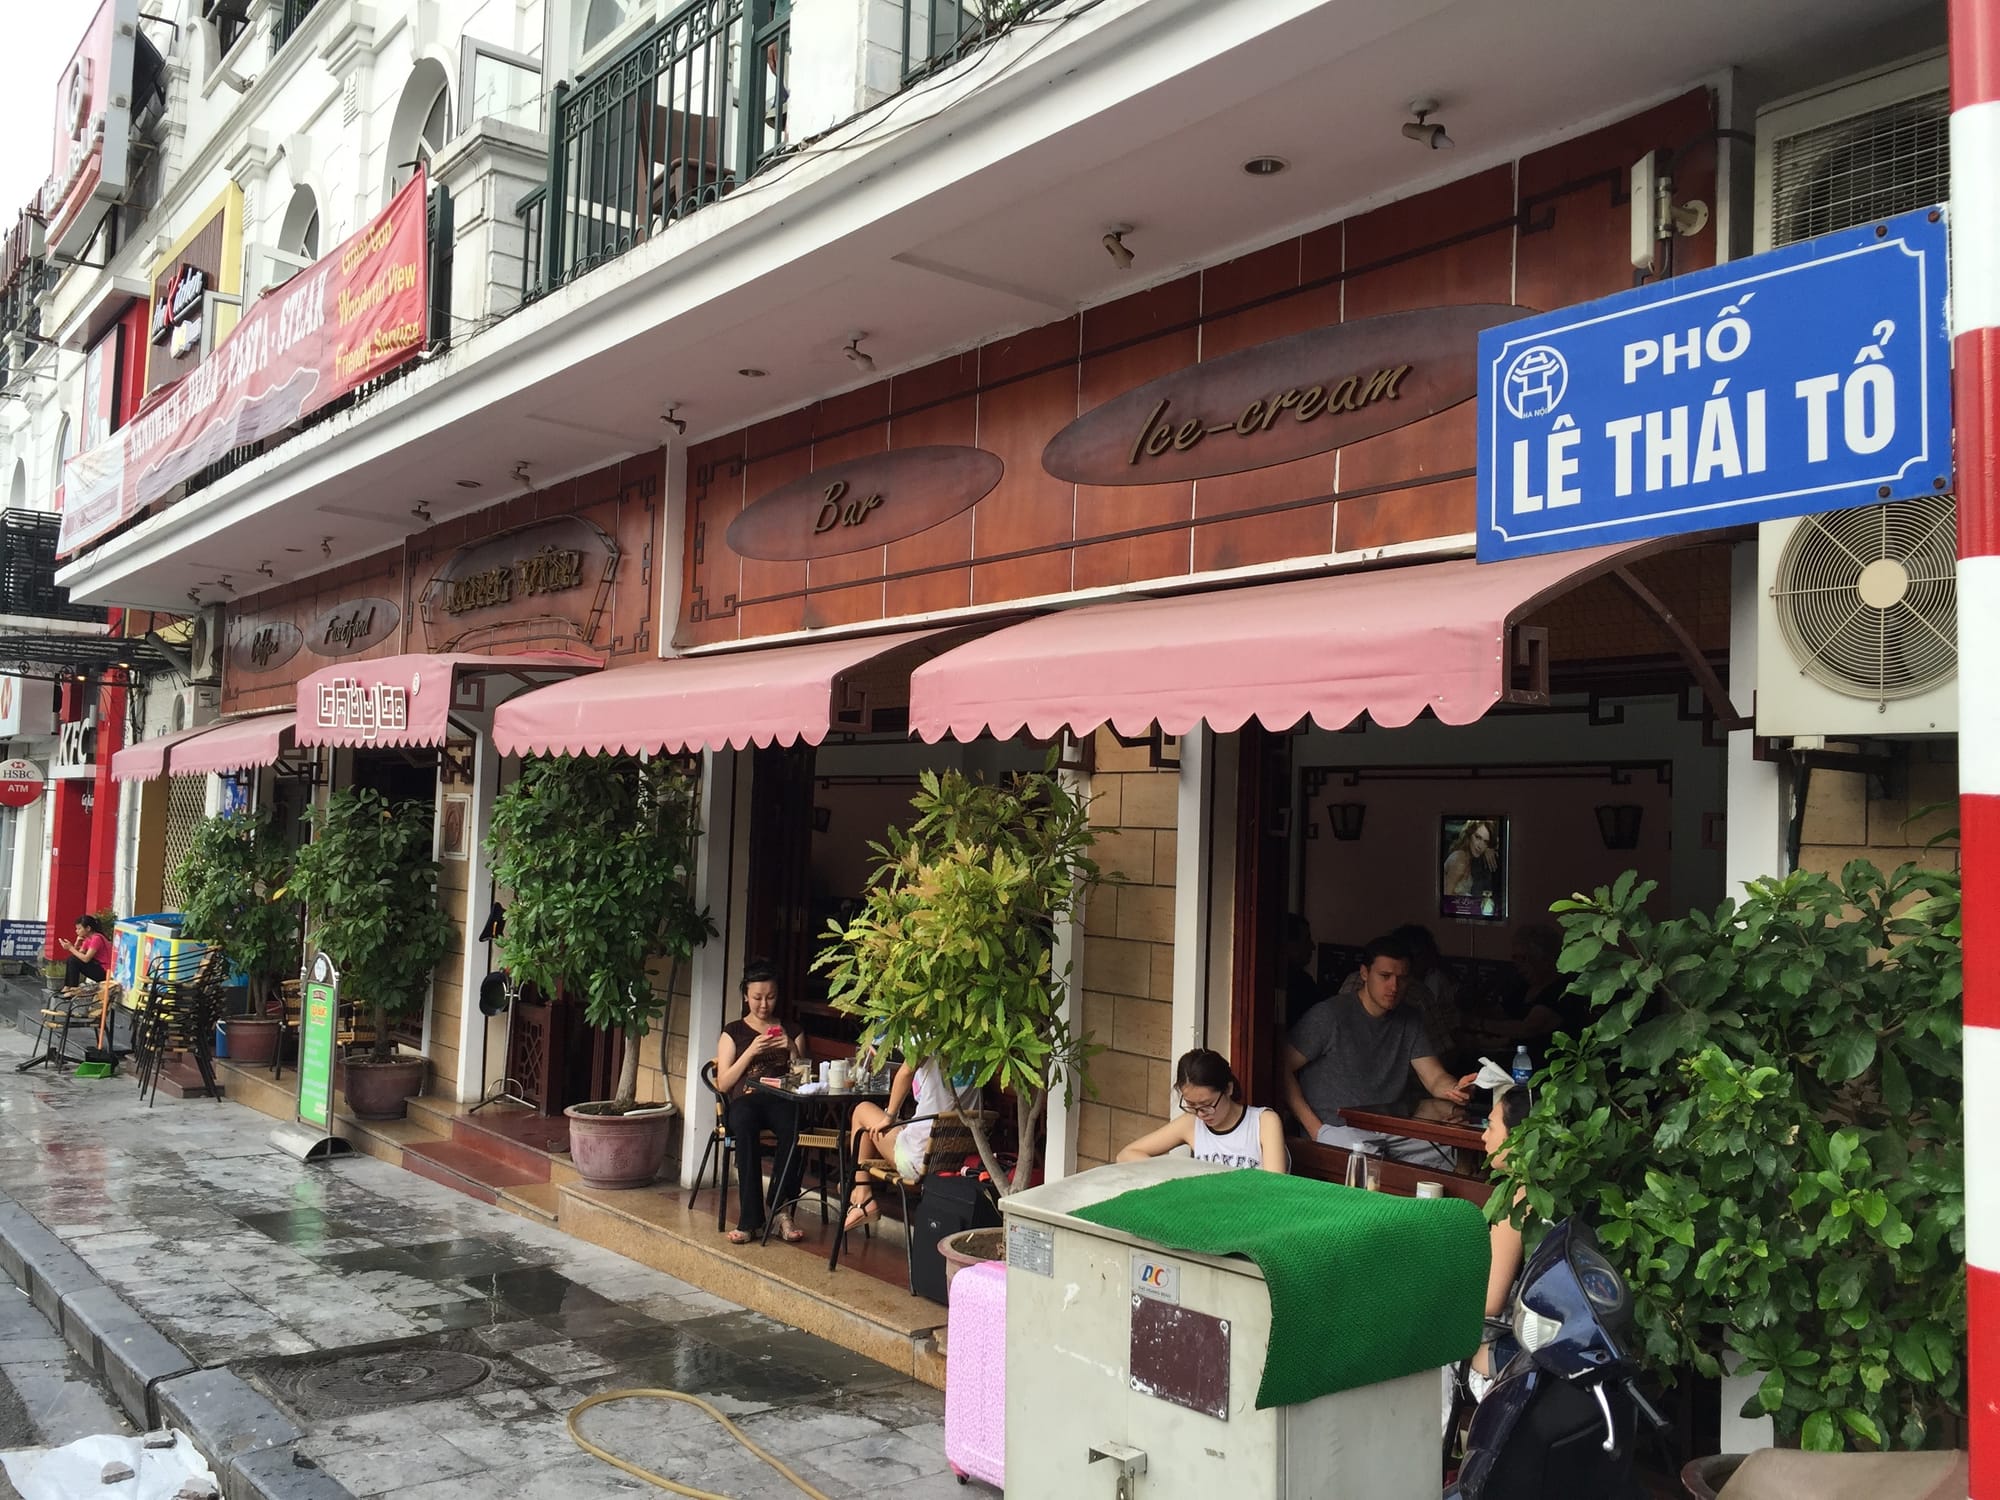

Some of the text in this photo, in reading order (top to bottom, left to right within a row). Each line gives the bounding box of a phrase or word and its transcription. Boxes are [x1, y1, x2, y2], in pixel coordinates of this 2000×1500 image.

[387, 261, 418, 297] View
[227, 312, 269, 392] PASTA
[277, 267, 329, 356] STEAK
[1623, 291, 1756, 385] PHỐ
[335, 335, 371, 381] Friendly
[1127, 360, 1413, 465] Ice-cream
[1512, 319, 1897, 515] LÊ THÁI TỔ
[813, 479, 885, 534] Bar
[57, 717, 90, 767] KFC
[3, 769, 35, 779] HSBC
[7, 784, 29, 793] ATM
